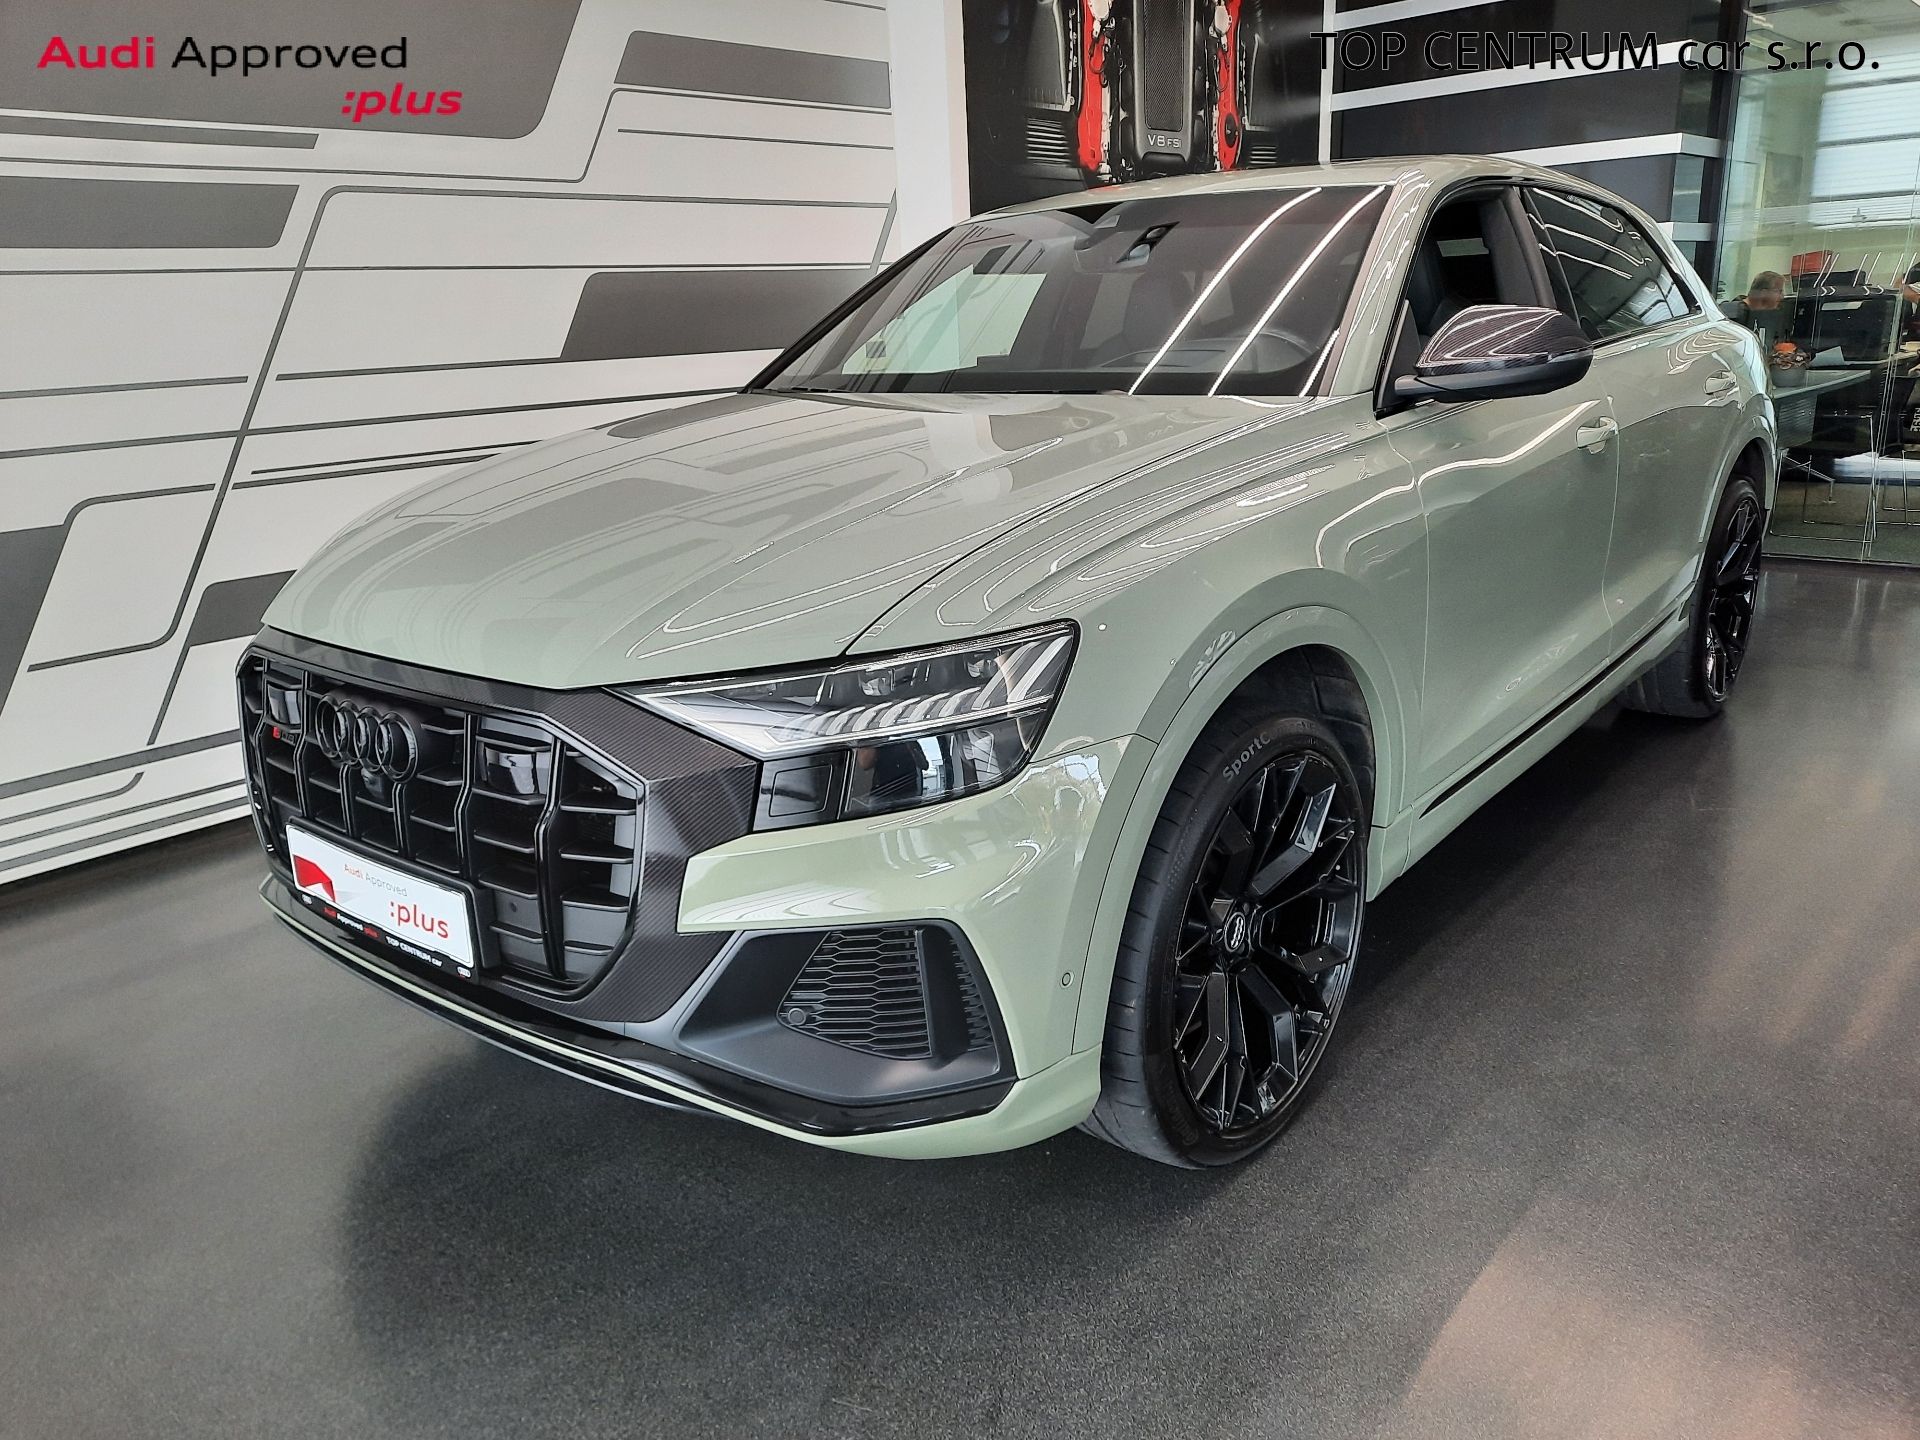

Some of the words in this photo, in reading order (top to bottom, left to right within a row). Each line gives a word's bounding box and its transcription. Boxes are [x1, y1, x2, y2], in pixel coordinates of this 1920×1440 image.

[1147, 134, 1166, 147] V8
[344, 863, 364, 879] Audi
[365, 872, 408, 897] Approved
[390, 901, 449, 939] :plus
